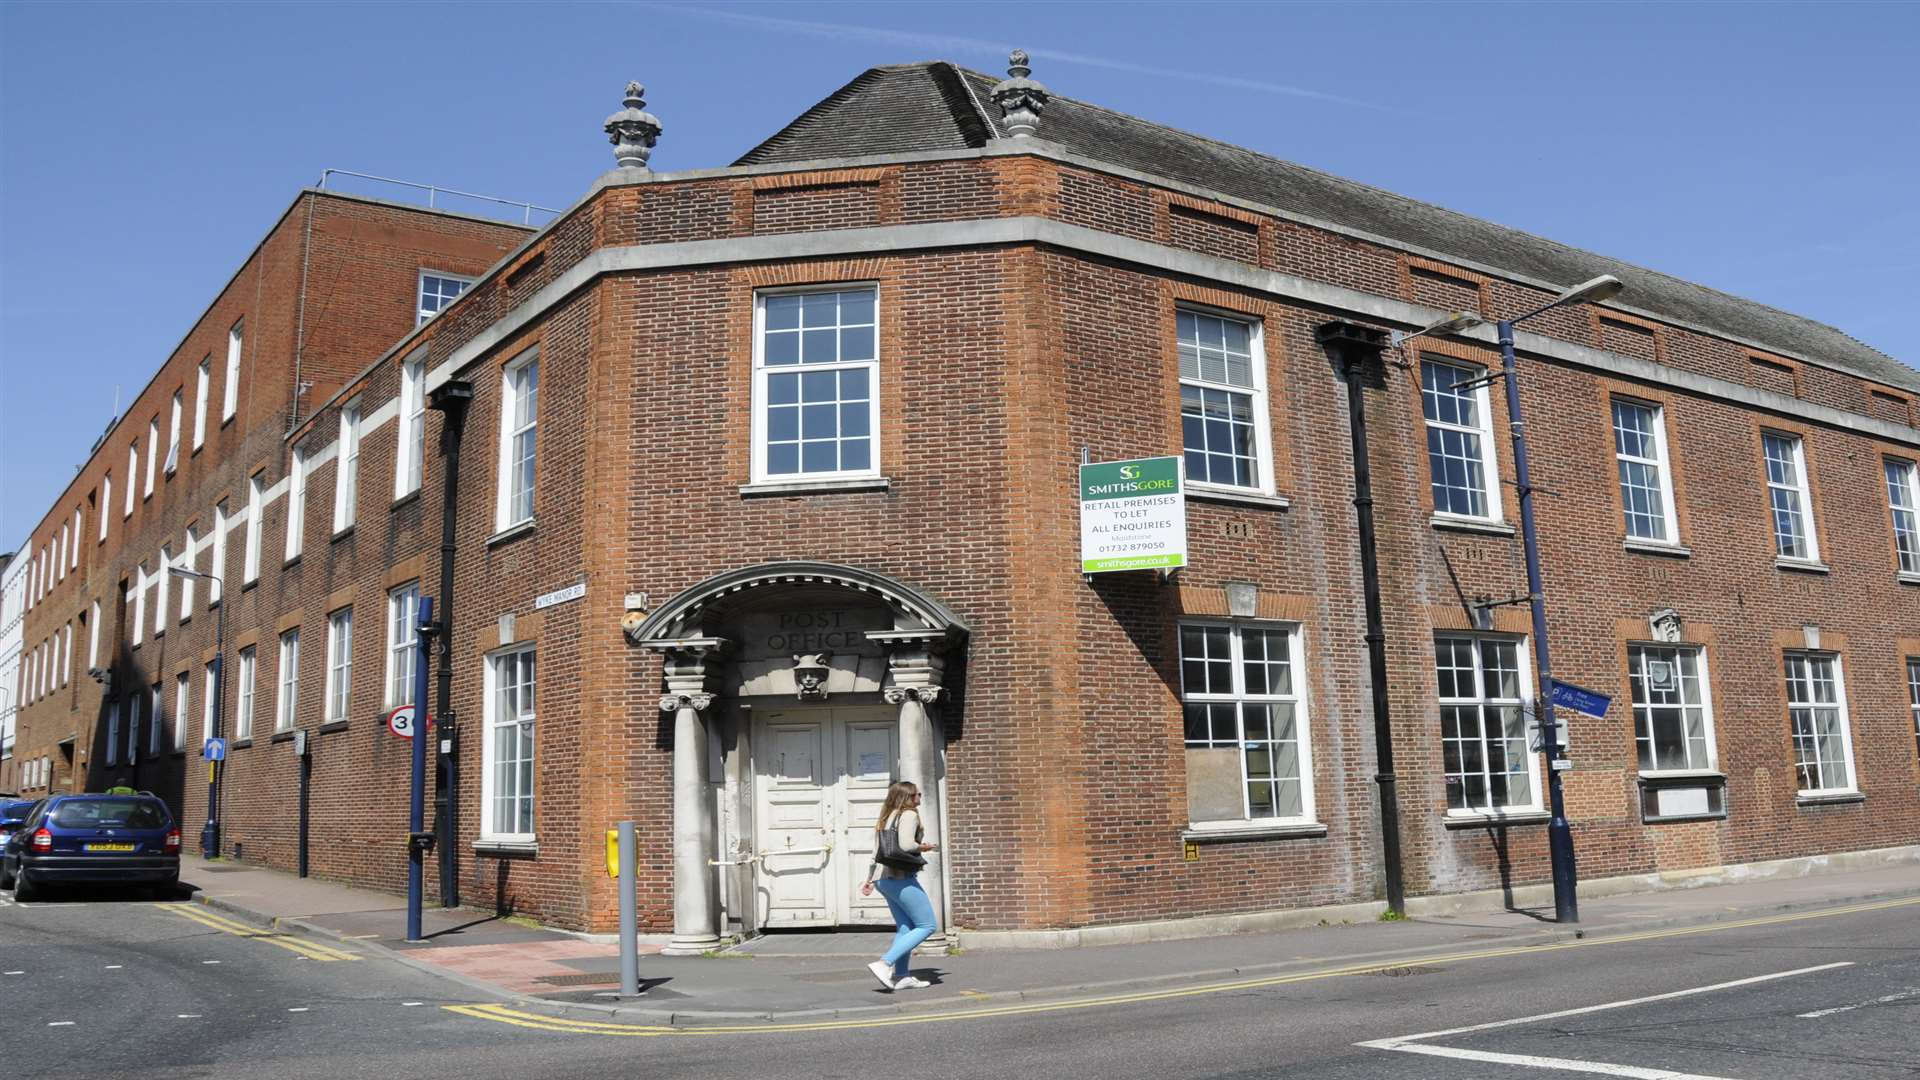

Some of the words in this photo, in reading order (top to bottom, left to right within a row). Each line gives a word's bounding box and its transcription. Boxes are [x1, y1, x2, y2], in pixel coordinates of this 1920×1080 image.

[1088, 479, 1174, 495] SMITHSGORE
[1084, 501, 1120, 511] RETAIL
[1124, 496, 1176, 508] PREMISES
[1114, 511, 1127, 519] TO
[1130, 509, 1148, 518] LET
[1092, 525, 1110, 533] ALL
[1113, 520, 1172, 532] ENQUIRIES
[1098, 544, 1128, 553] 01732
[1130, 542, 1165, 551] 879050
[1097, 556, 1169, 569] smithsgore.co.uk
[538, 595, 553, 607] WYKE
[554, 589, 573, 602] MANOR
[573, 585, 582, 596] RD
[779, 611, 846, 629] POST
[767, 631, 860, 650] OFFICE
